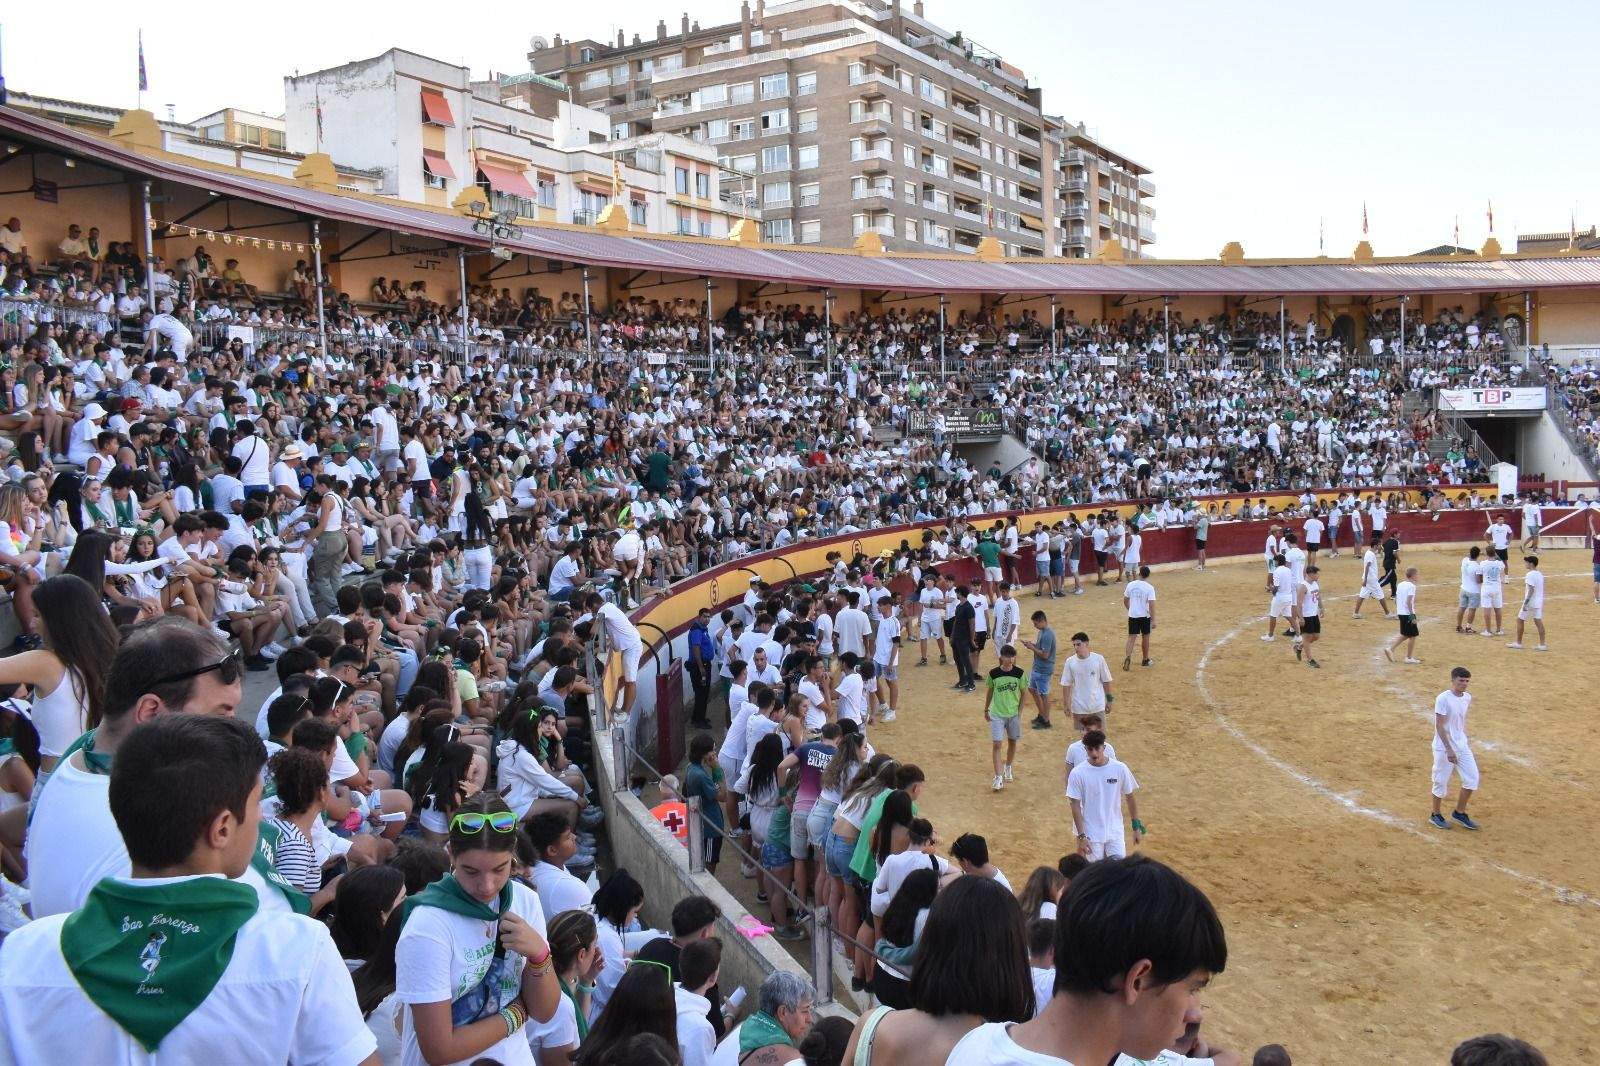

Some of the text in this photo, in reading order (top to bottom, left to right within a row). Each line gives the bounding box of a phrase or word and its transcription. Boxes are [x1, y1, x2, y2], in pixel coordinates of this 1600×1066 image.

[1473, 390, 1512, 404] TBP
[808, 749, 833, 763] HOLLIS
[121, 913, 201, 934] San Lorenzo
